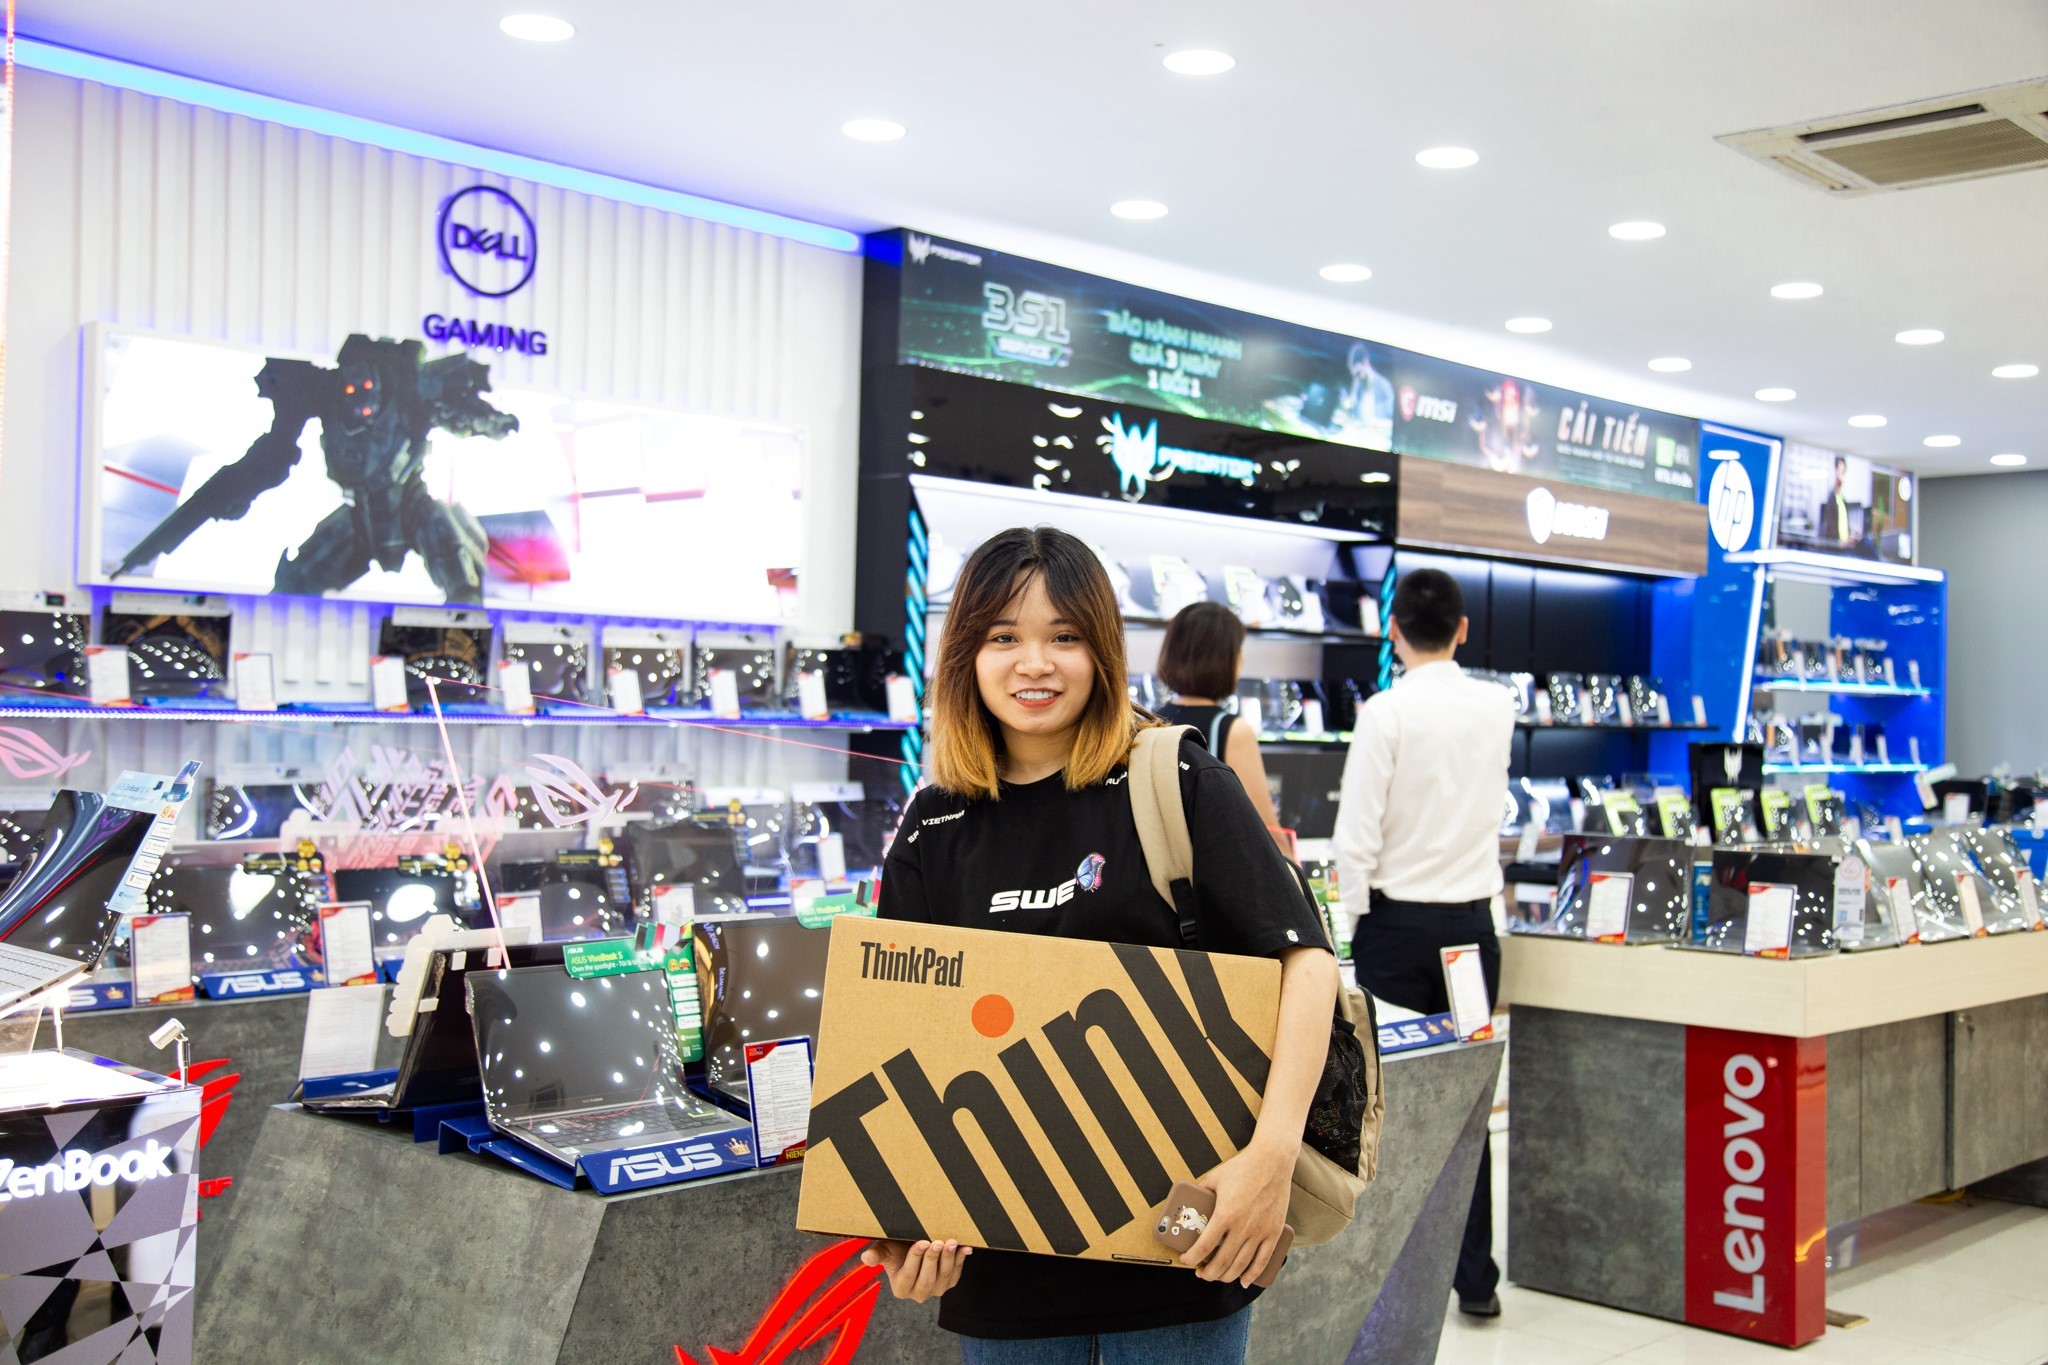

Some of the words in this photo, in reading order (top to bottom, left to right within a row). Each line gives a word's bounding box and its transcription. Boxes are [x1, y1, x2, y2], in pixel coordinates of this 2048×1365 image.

[453, 223, 528, 262] DELL
[423, 313, 548, 357] GAMING
[1556, 400, 1598, 447] CẢI
[1601, 411, 1650, 458] TIẾN
[1157, 444, 1255, 480] PREDATOR
[921, 810, 965, 826] VIETNAM
[218, 971, 306, 995] ASUS
[861, 941, 964, 988] ThinkPad
[1378, 1023, 1429, 1048] SUS
[806, 943, 1272, 1256] Think
[608, 1143, 723, 1186] ASUS
[1713, 1053, 1766, 1314] Lenovo
